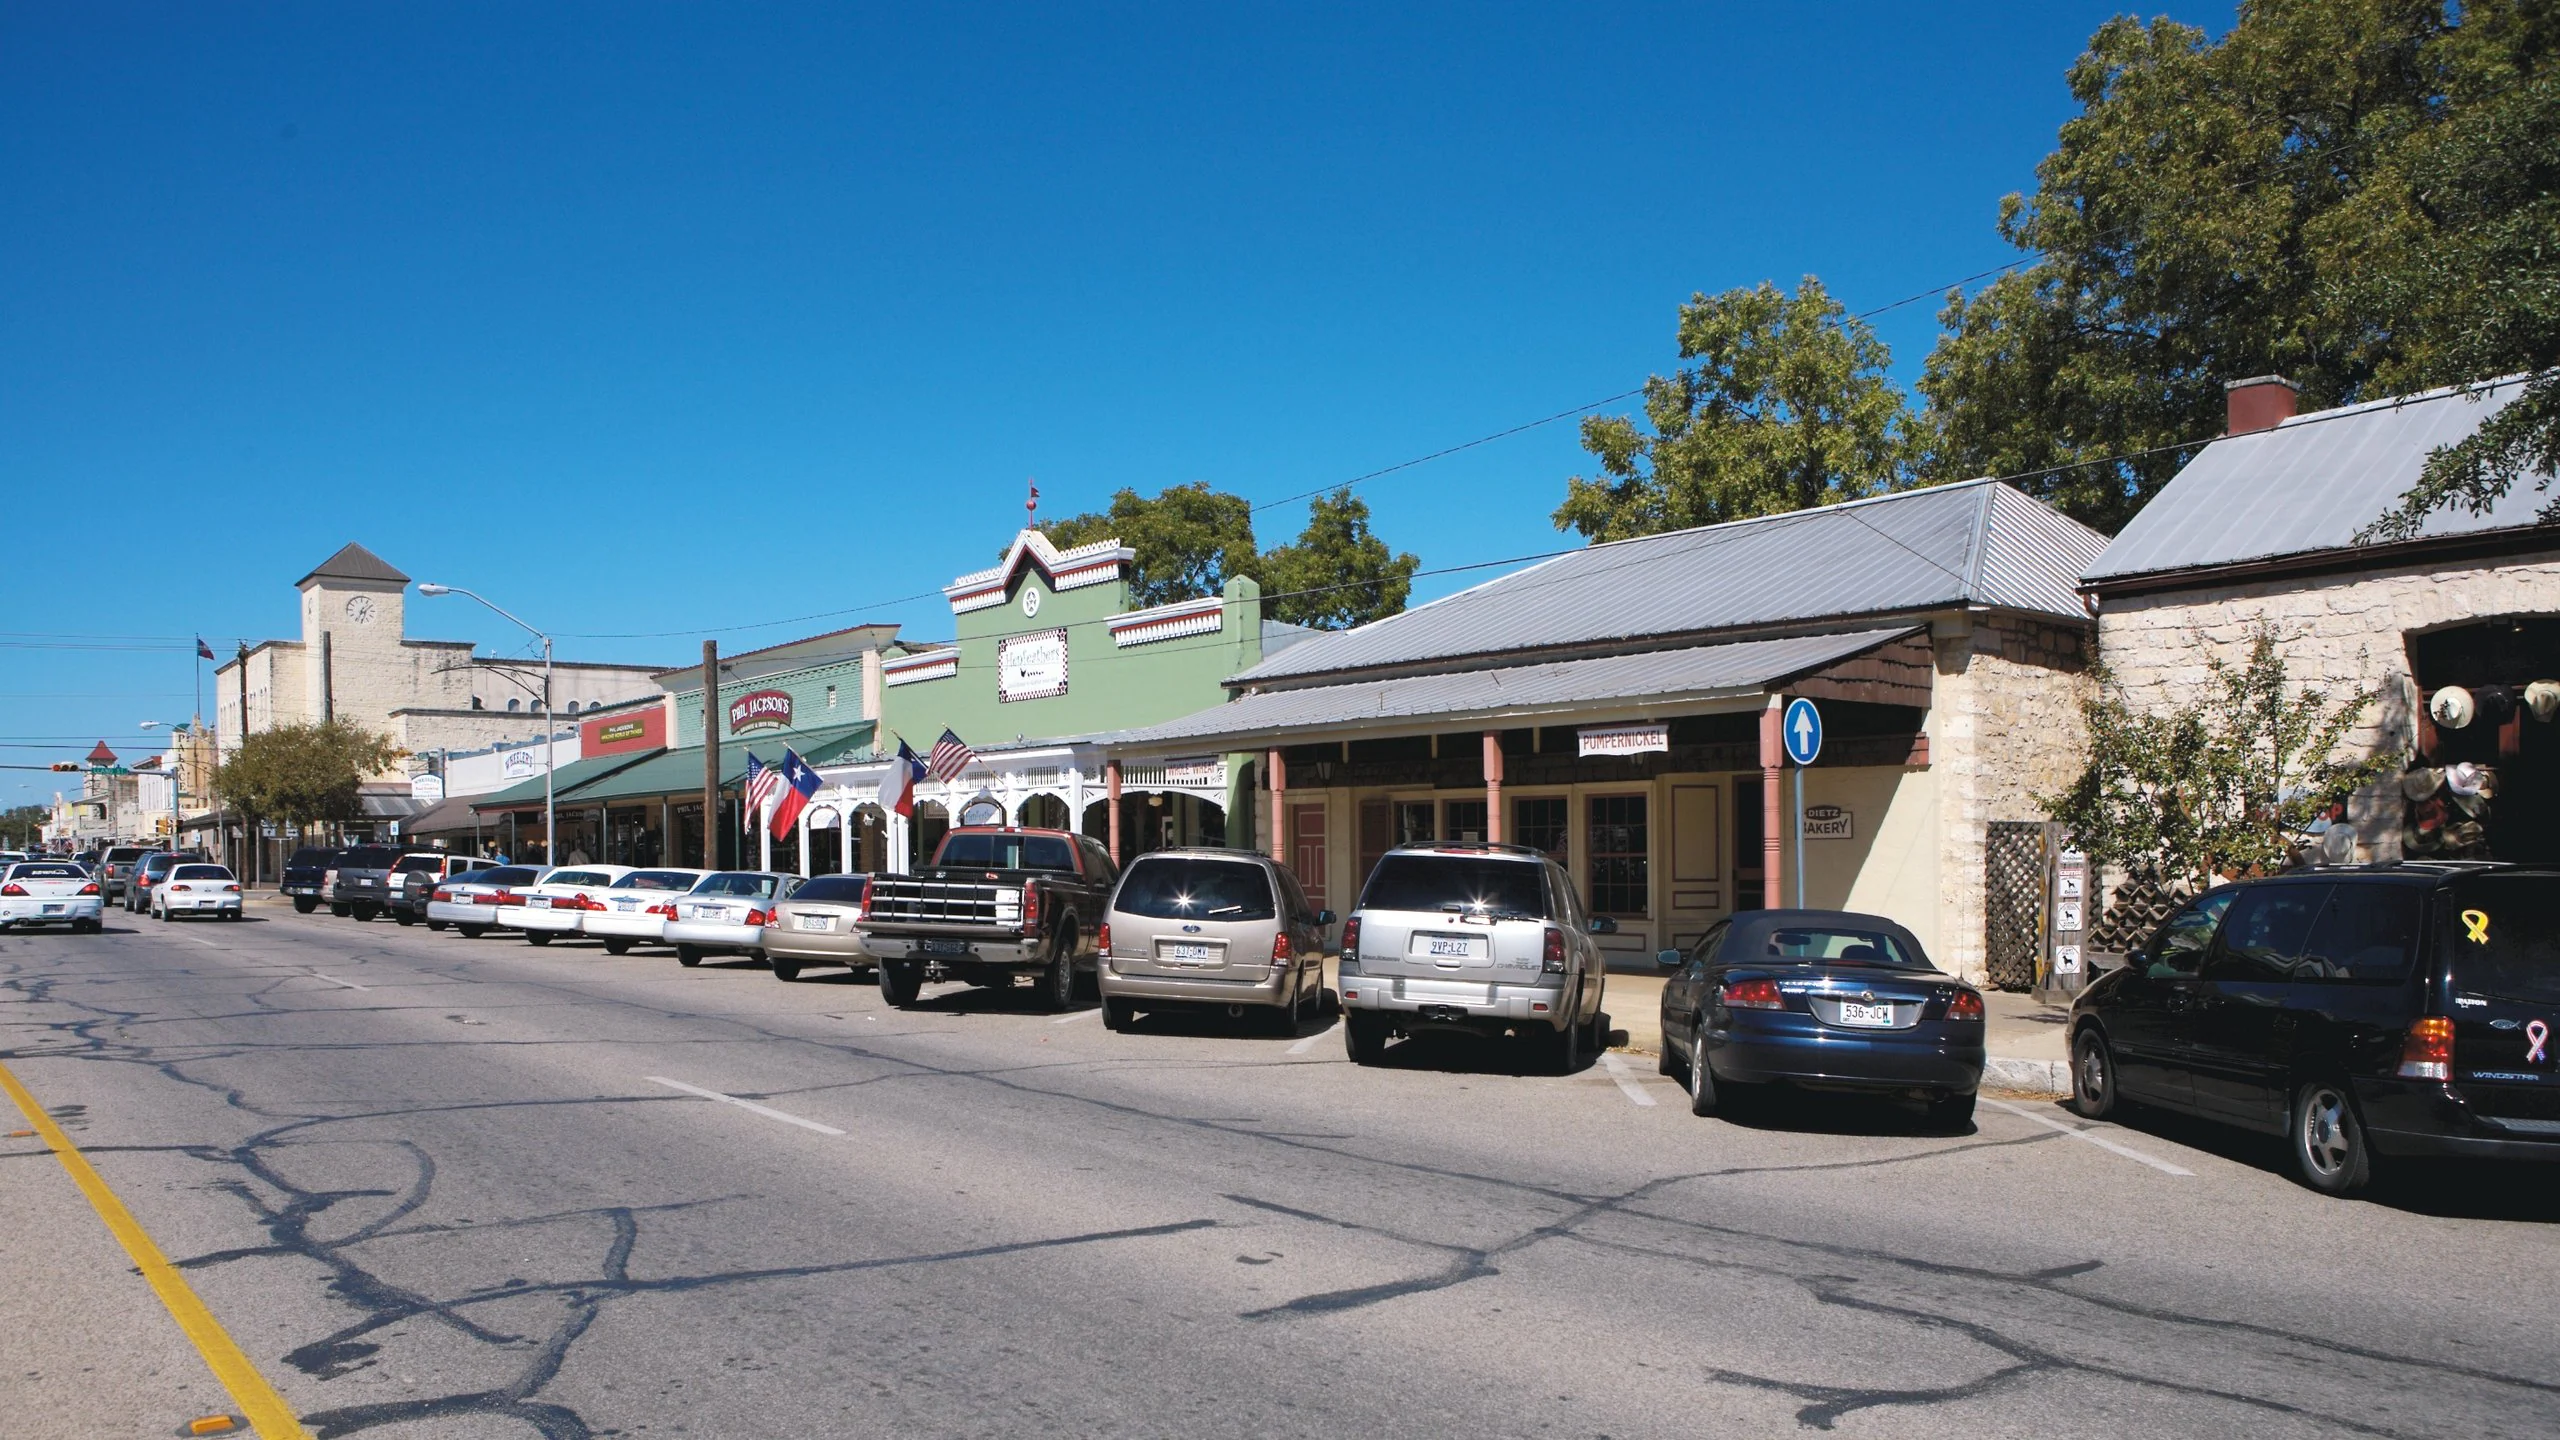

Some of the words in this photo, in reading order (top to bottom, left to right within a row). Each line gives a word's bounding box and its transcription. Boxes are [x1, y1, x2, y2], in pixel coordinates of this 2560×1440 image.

[731, 702, 748, 724] PHIL
[749, 696, 790, 718] JACKSON'S
[1583, 730, 1664, 750] PUMPERNICKEL
[178, 733, 186, 791] PALACE
[1167, 763, 1189, 776] WHOLE
[1192, 760, 1215, 774] WHEAT
[1808, 809, 1839, 817] DIETZ
[1846, 1005, 1889, 1019] 536-JCW
[2472, 1072, 2539, 1080] WINDSTAR
